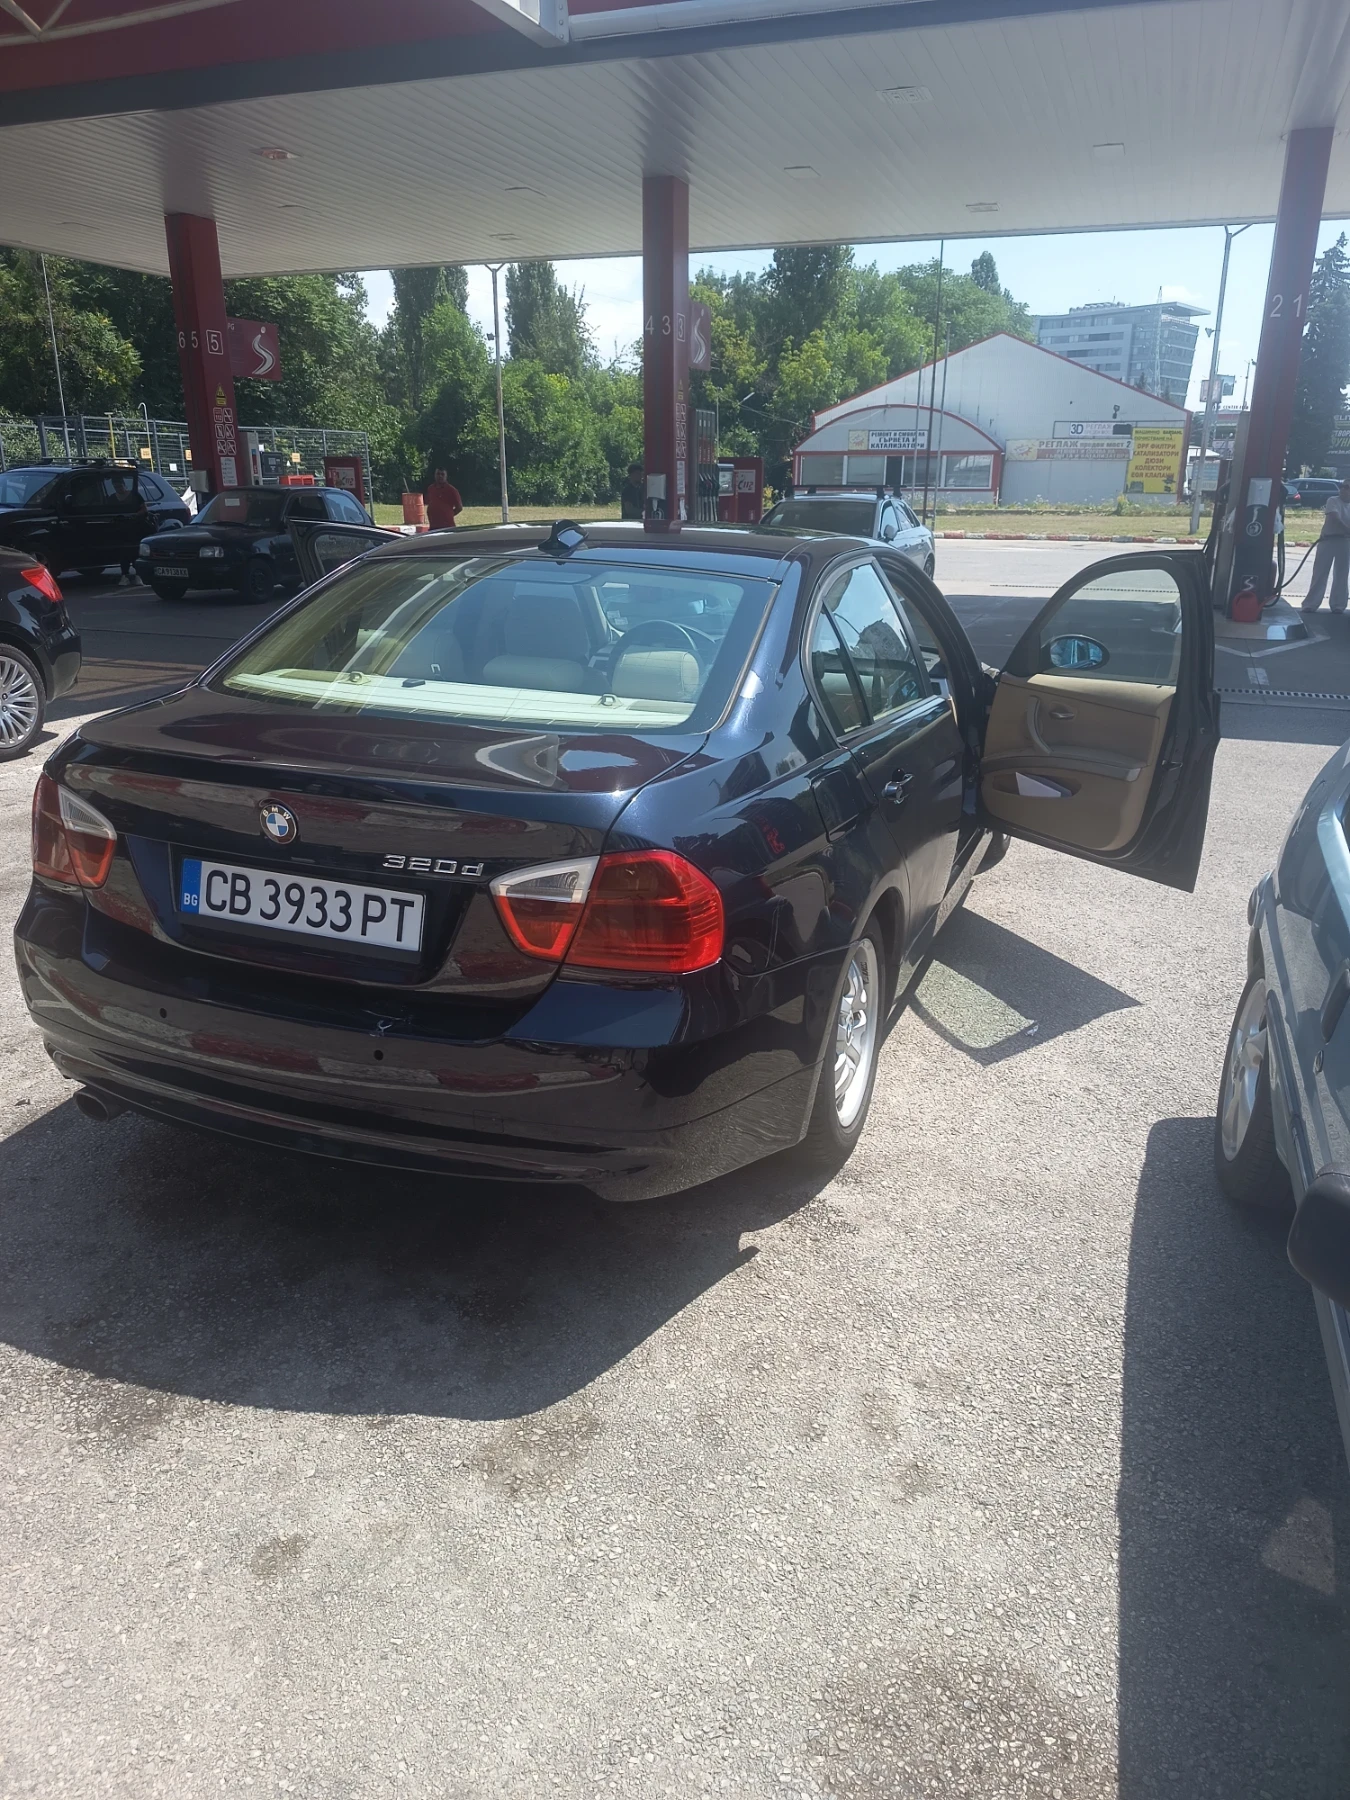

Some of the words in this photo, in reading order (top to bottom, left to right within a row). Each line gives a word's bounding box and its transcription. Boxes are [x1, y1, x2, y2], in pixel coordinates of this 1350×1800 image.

[1270, 294, 1283, 317] 2
[1293, 294, 1302, 317] 1
[645, 315, 654, 335] 4
[662, 315, 671, 335] 3
[178, 331, 186, 348] 6
[191, 331, 198, 348] 5
[210, 334, 219, 351] 5
[1070, 424, 1084, 435] 3D
[261, 806, 292, 821] BMW
[382, 854, 485, 877] 320d
[183, 892, 198, 907] BG
[205, 869, 251, 915] CB
[259, 878, 352, 933] 3933
[360, 893, 415, 943] PT
